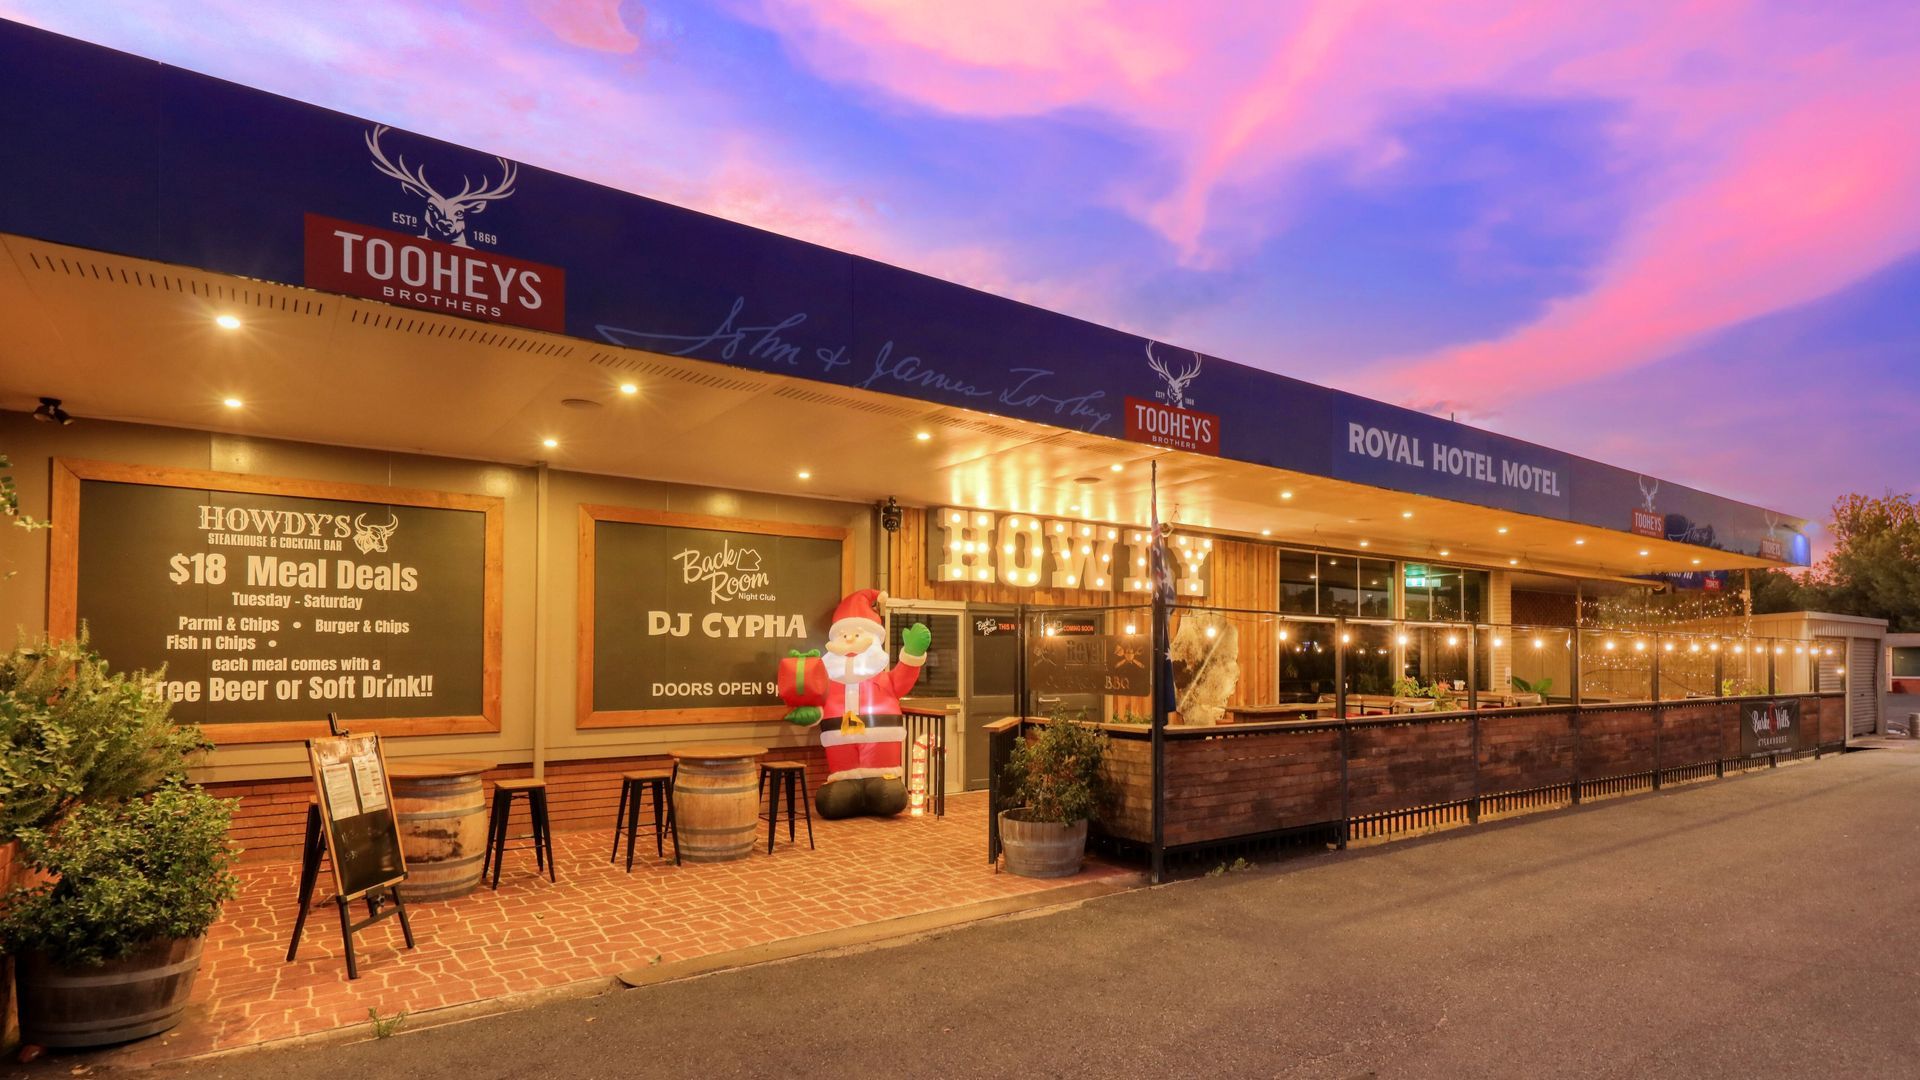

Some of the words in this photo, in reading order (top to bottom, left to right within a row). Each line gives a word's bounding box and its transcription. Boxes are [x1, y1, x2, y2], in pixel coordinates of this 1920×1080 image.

[473, 230, 497, 245] 1869
[333, 230, 542, 309] TOOHEYS
[383, 286, 501, 317] BROTHERS
[854, 341, 992, 396] James
[1135, 405, 1211, 443] TOOHEYS
[1152, 435, 1196, 449] BROTHERS
[1349, 422, 1424, 467] ROYAL
[1433, 443, 1497, 483] HOTEL
[1502, 460, 1560, 497] MOTEL
[198, 505, 351, 538] HOWDY'S
[1634, 512, 1662, 532] TOOHEYS
[208, 533, 268, 548] STEAKHOUSE
[270, 537, 277, 549] &
[279, 537, 321, 551] COCKTAIL
[323, 539, 342, 551] BAR
[169, 553, 227, 585] $18
[247, 555, 327, 588] Meal
[337, 560, 418, 592] Deals
[672, 538, 737, 584] Back
[232, 592, 291, 609] Tuesday
[304, 595, 363, 610] Saturday
[701, 570, 769, 605] Room
[738, 592, 757, 601] Night
[759, 593, 776, 601] Club
[179, 616, 222, 631] Parmi
[226, 618, 236, 631] &
[240, 617, 280, 632] Chips
[315, 619, 359, 634] Burger
[363, 621, 371, 633] &
[375, 620, 410, 634] Chips
[648, 611, 692, 637] DJ
[702, 612, 808, 638] CYPHA
[166, 635, 198, 650] Fish
[202, 638, 212, 650] n
[215, 636, 256, 651] Chips
[212, 658, 248, 671] each
[252, 658, 287, 671] meal
[291, 661, 337, 671] comes
[340, 657, 369, 671] with
[372, 660, 381, 671] a
[209, 677, 268, 701] Beer
[275, 681, 302, 700] or
[309, 676, 355, 699] Soft
[362, 674, 433, 698] Drink!!
[652, 683, 713, 697] DOORS
[718, 682, 762, 696] OPEN
